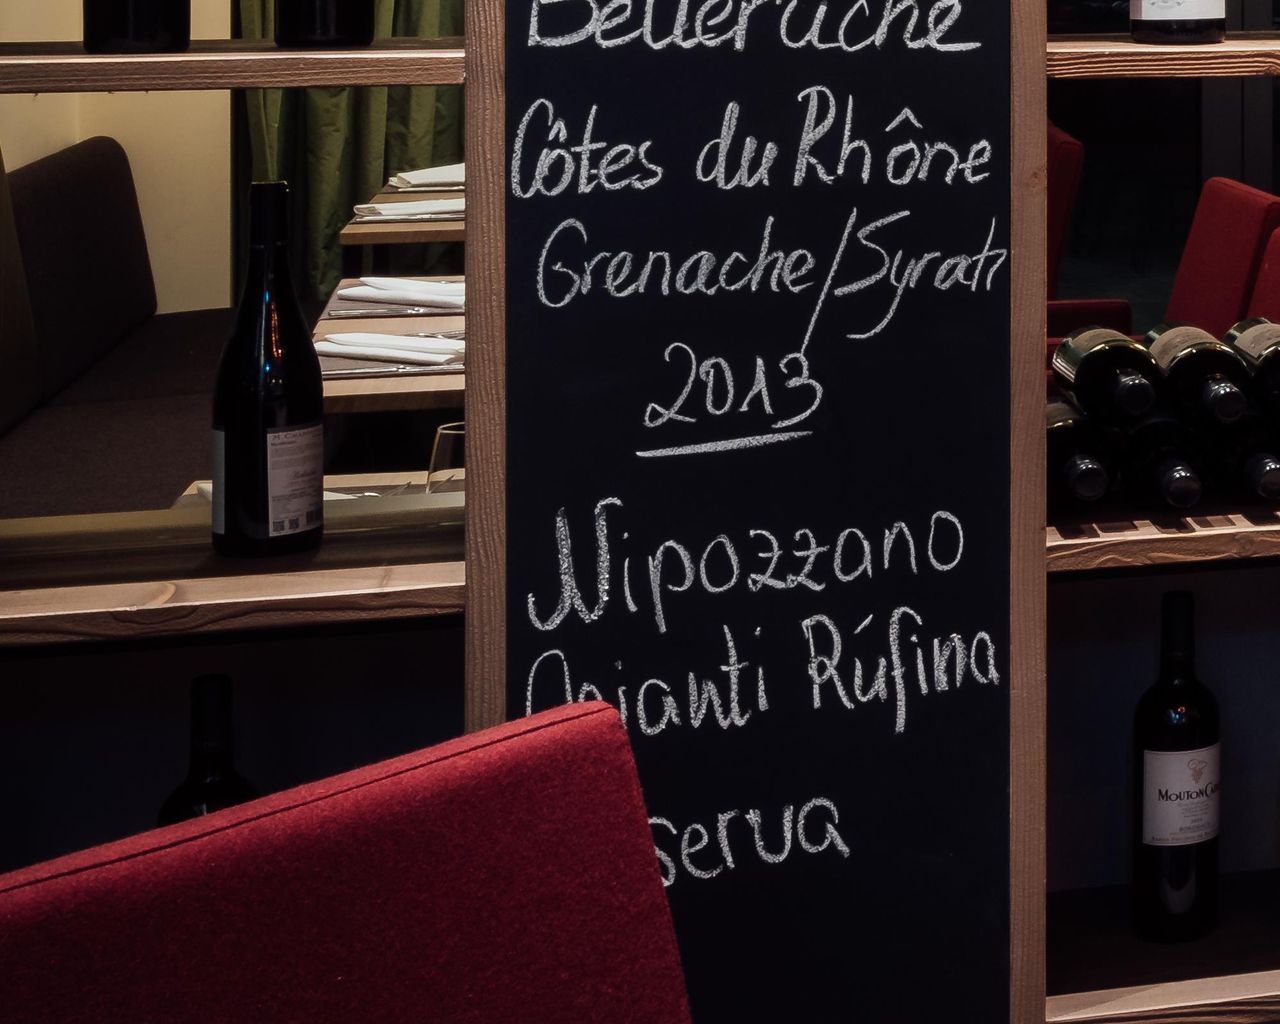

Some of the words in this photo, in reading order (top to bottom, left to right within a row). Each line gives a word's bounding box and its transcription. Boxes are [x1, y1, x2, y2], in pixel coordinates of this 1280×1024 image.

[511, 98, 664, 199] Côtes
[696, 101, 780, 190] du
[793, 84, 993, 187] Rhône
[644, 343, 823, 428] 2013
[528, 497, 964, 634] Nipozzano
